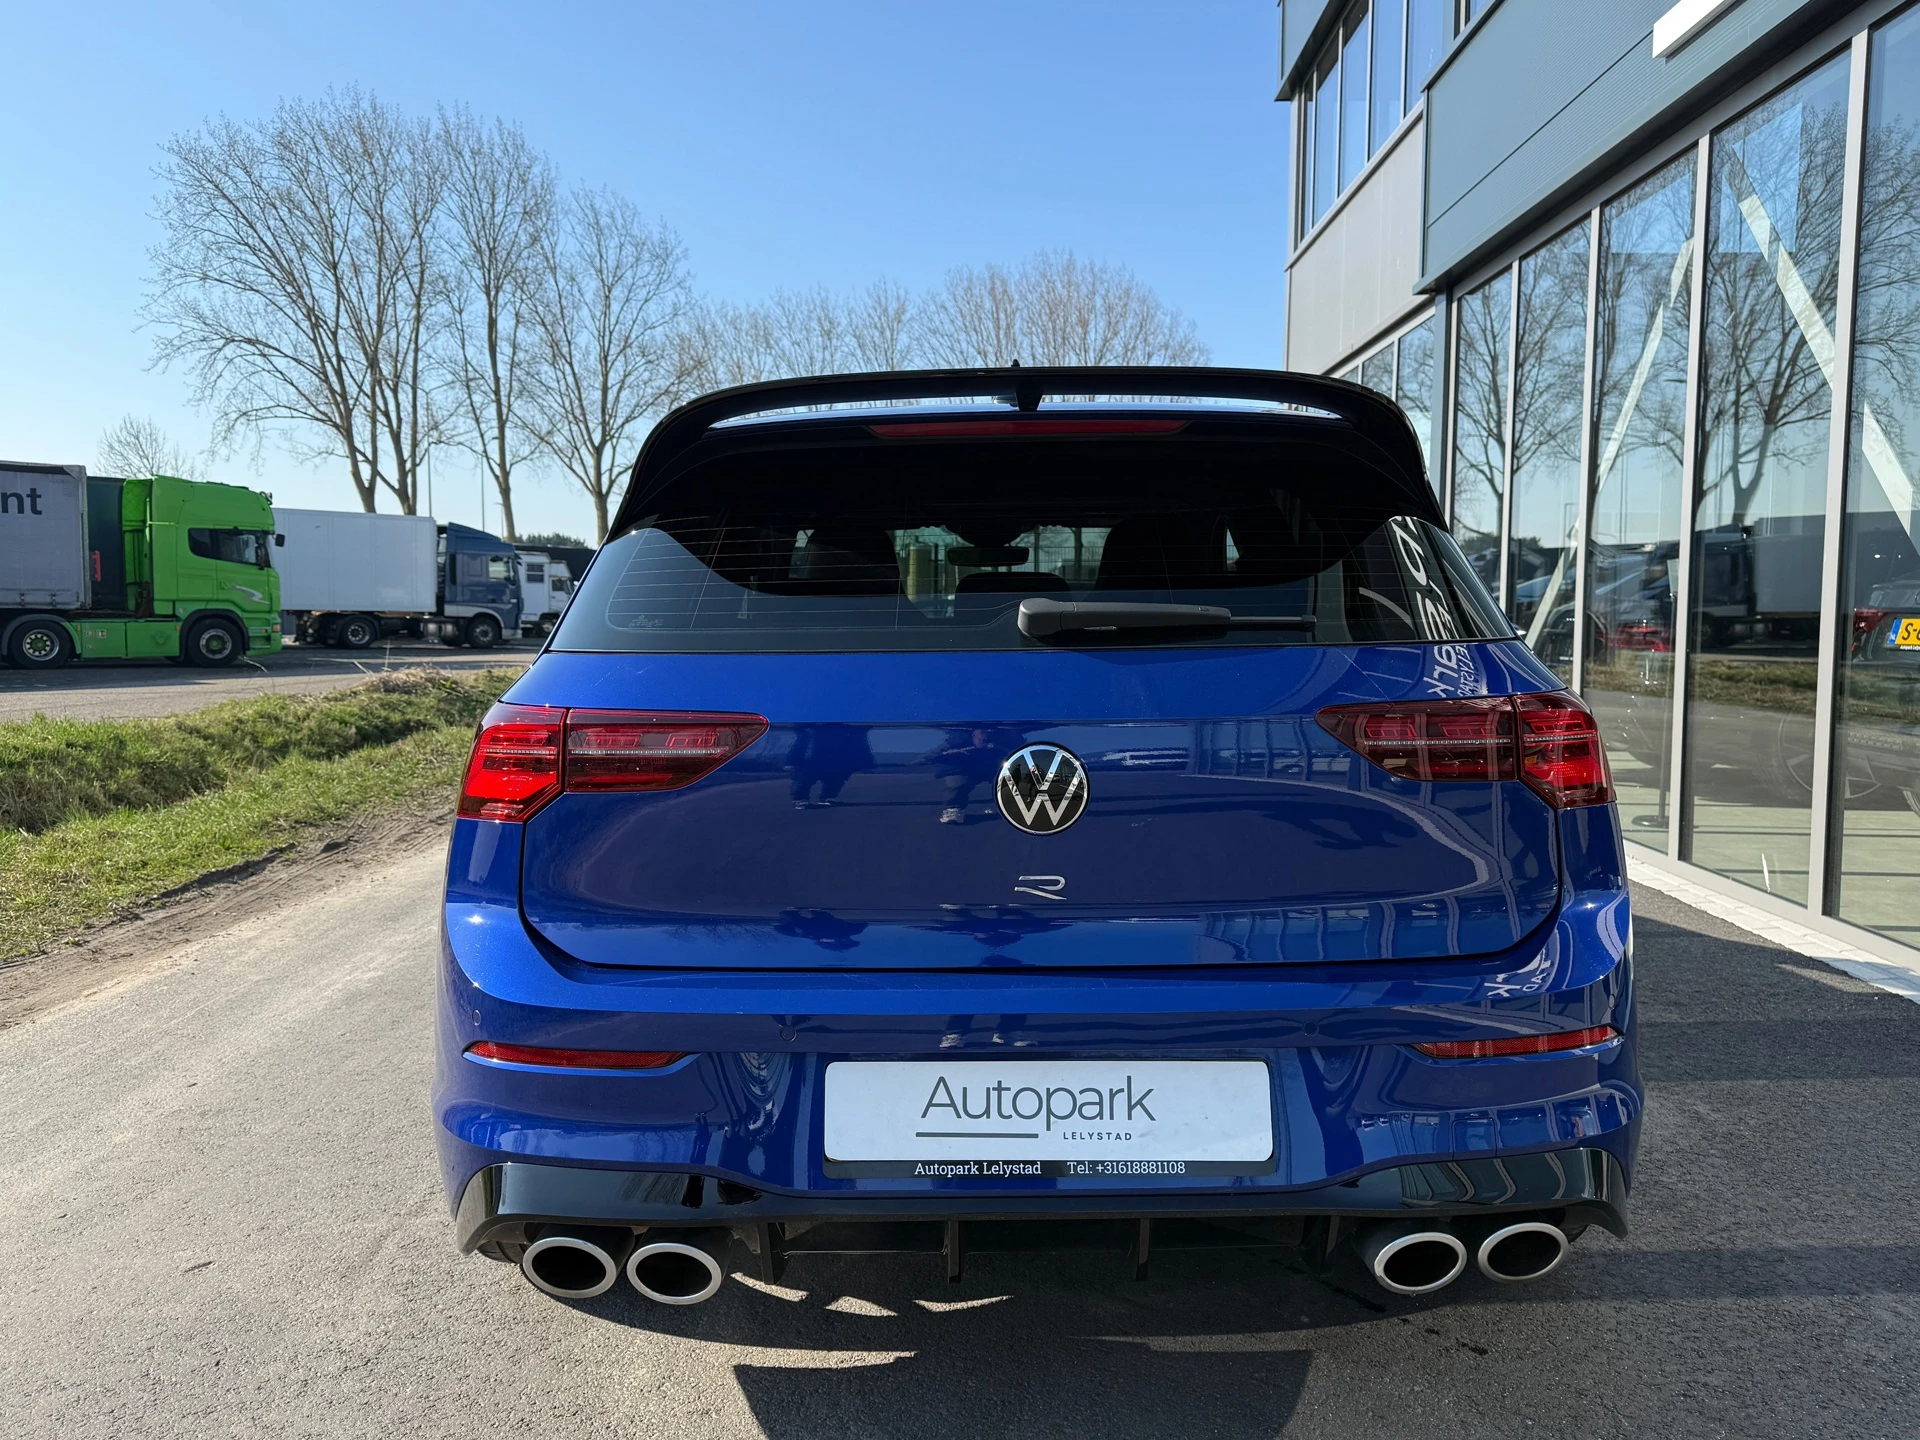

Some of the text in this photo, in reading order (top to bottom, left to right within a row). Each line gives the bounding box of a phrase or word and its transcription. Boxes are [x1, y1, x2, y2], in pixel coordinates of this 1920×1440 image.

[920, 1075, 1157, 1132] Autopark
[1062, 1131, 1133, 1141] LELYSTAD
[914, 1161, 1186, 1178] Autopark Lelystad Tel: +31618881108
